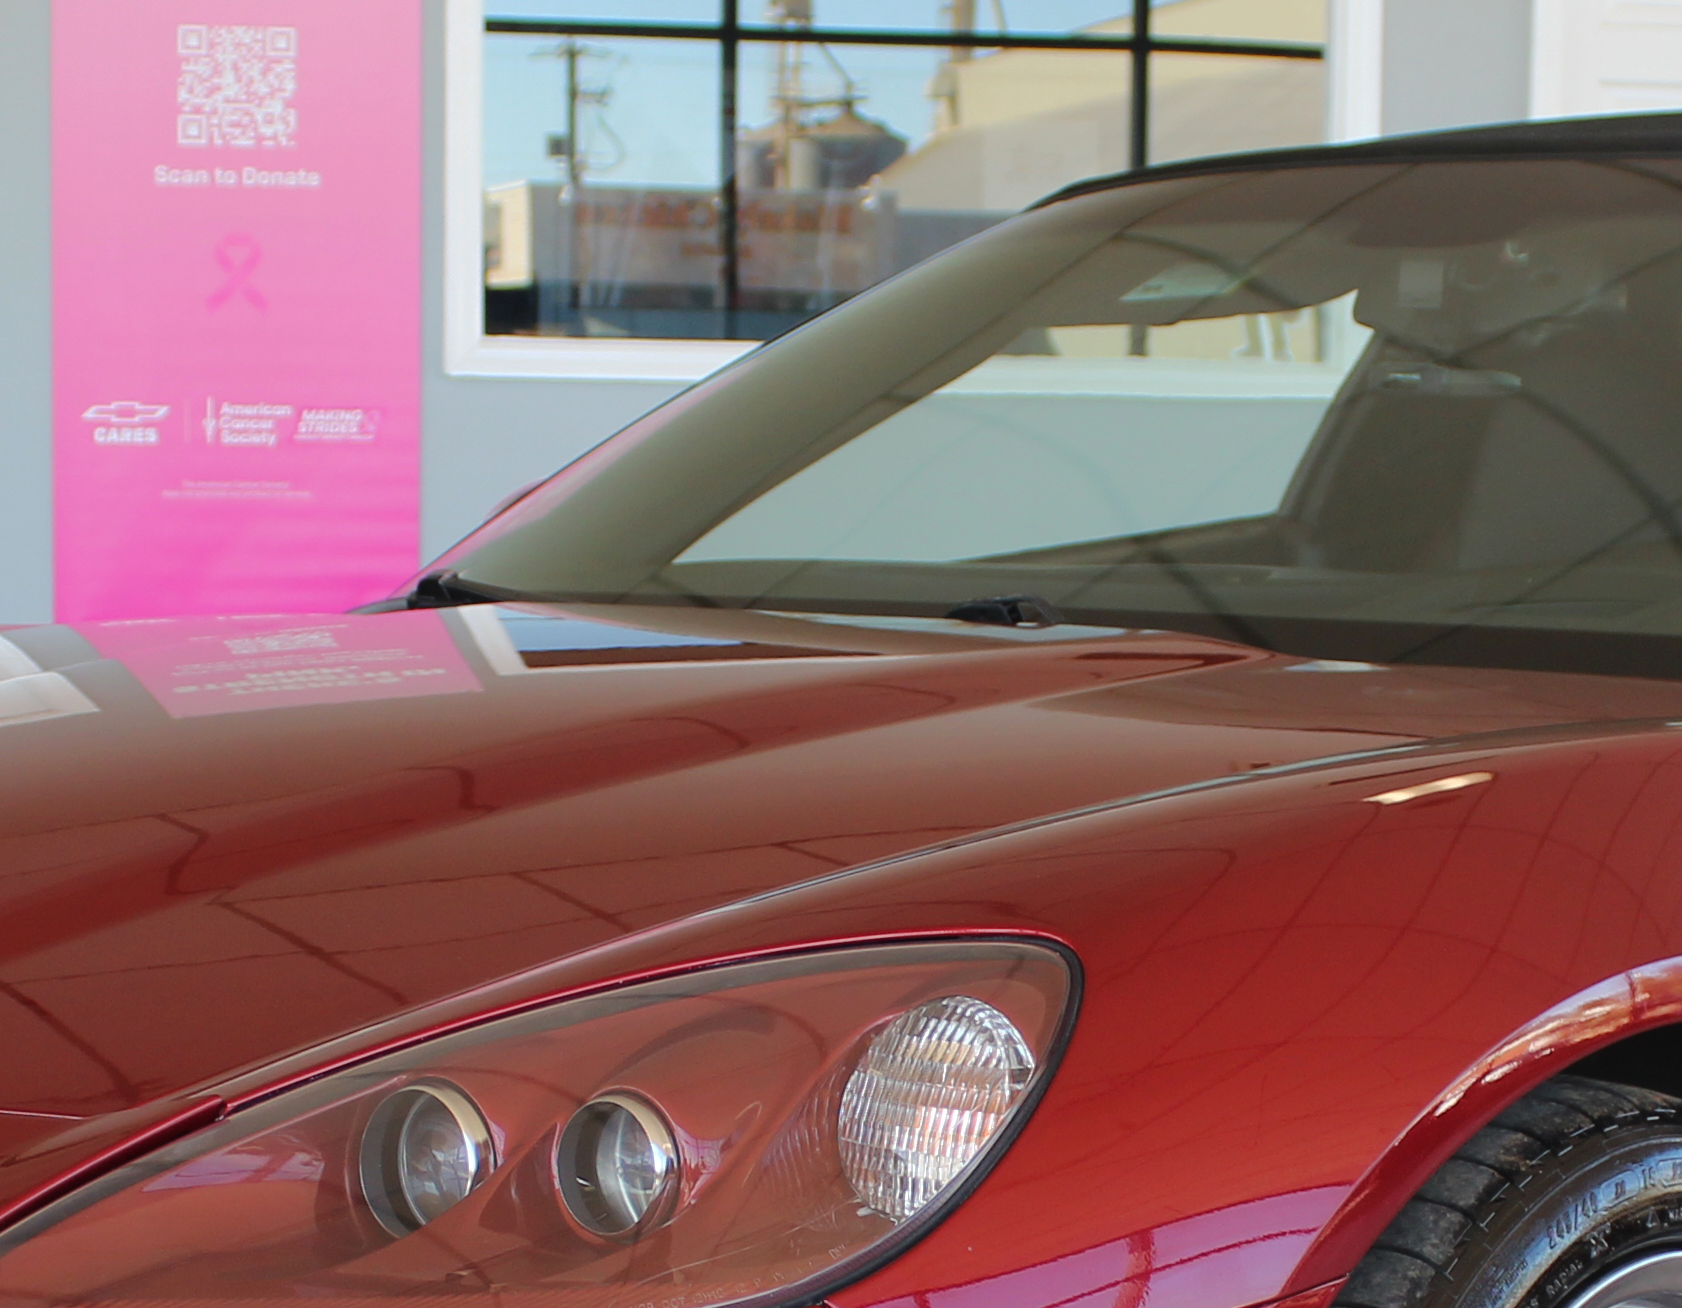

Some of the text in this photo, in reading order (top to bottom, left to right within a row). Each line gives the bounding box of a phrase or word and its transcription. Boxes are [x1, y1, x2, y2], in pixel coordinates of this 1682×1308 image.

[154, 165, 321, 186] Scan to Donate
[220, 402, 293, 416] American
[302, 409, 363, 421] MAKING
[220, 416, 274, 430] Cancer
[297, 421, 359, 434] STRIDES
[94, 427, 159, 443] CARES
[221, 430, 276, 447] Society
[1546, 1255, 1584, 1299] RADIAL
